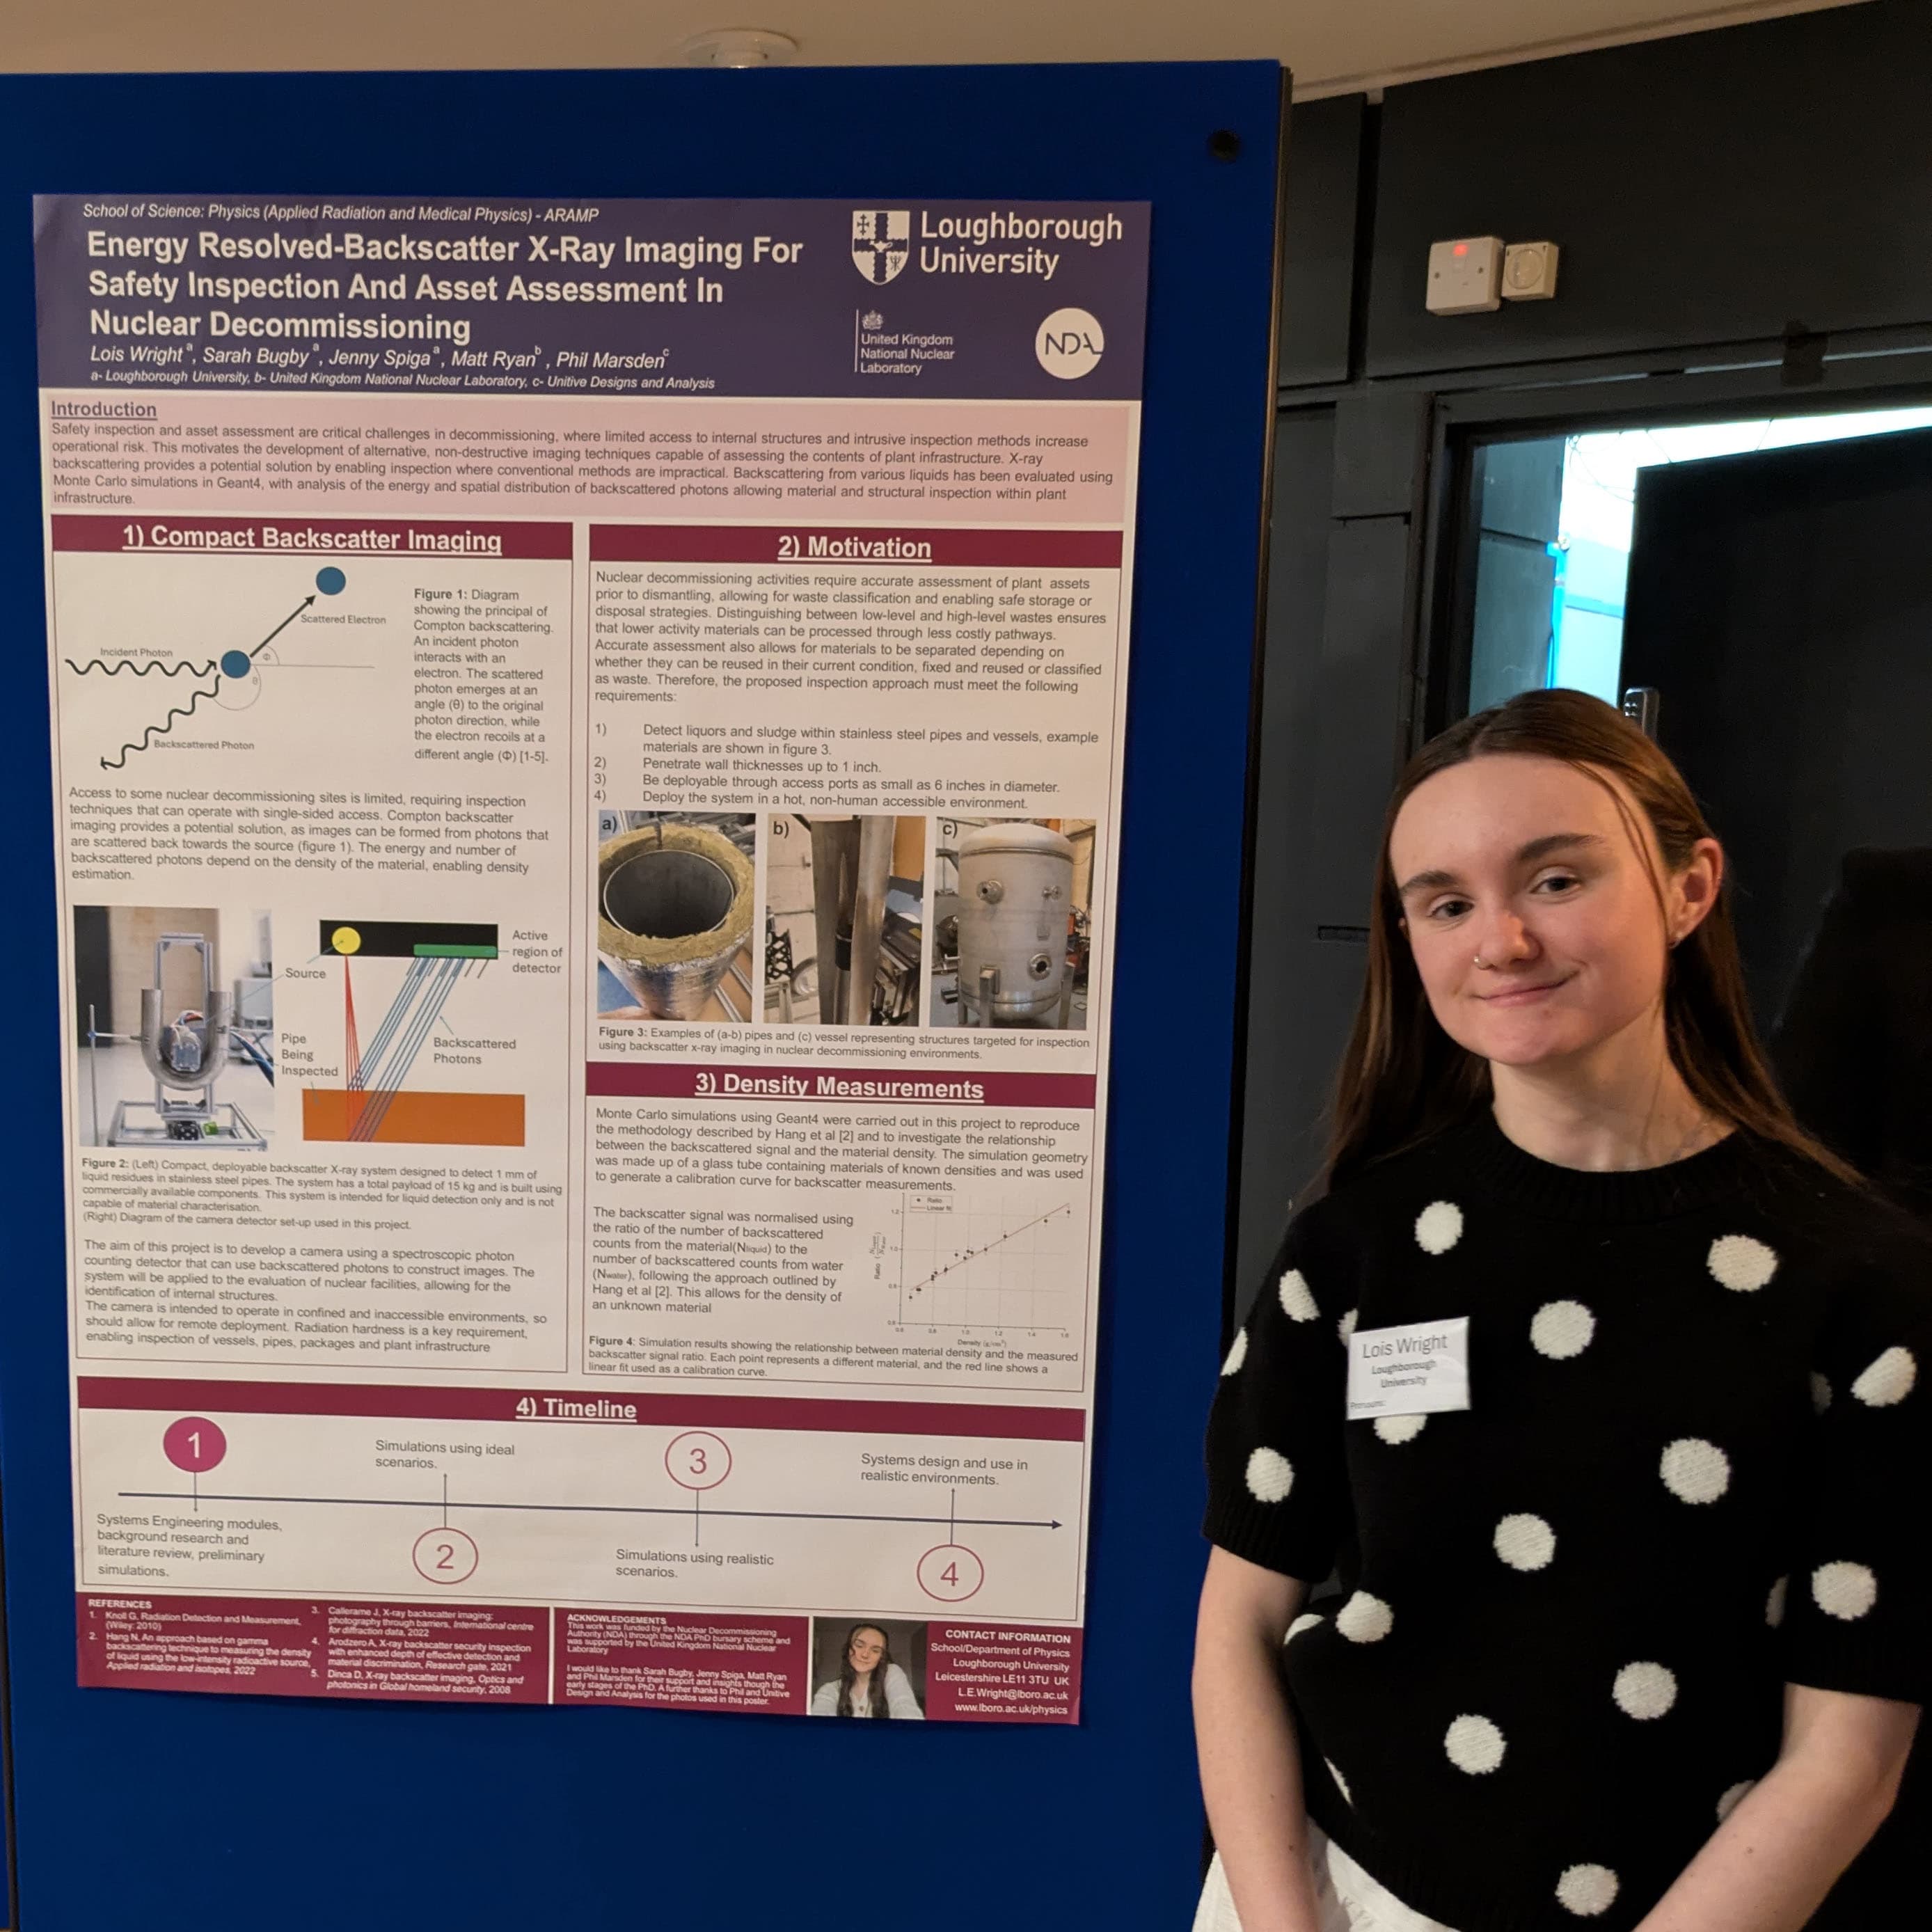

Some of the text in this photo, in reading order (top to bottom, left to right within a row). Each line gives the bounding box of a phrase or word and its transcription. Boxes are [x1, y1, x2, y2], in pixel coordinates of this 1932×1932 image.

[83, 203, 129, 217] School
[130, 203, 145, 217] of
[148, 203, 205, 218] Science:
[207, 203, 260, 221] Physics
[263, 204, 319, 221] (Applied
[322, 205, 386, 220] Radiation
[388, 206, 415, 220] and
[418, 205, 472, 221] Medical
[474, 206, 532, 224] Physics)
[543, 207, 599, 223] ARAMP
[921, 210, 1122, 246] Loughborough
[88, 230, 803, 269] Energy Resolved-Backscatter X-Ray Imaging For
[920, 246, 1059, 280] University
[88, 269, 722, 303] Safety Inspection And Asset Assessment In
[90, 309, 470, 346] Nuclear Decommissioning
[860, 333, 953, 348] United Kingdom
[1045, 333, 1104, 354] NDA
[90, 346, 588, 368] Lois Sarah Jenny Matt Phil
[860, 347, 955, 359] National Nuclear
[860, 361, 922, 376] Laboratory
[105, 370, 188, 385] Loughborough
[192, 370, 250, 386] University,
[269, 371, 308, 383] United
[310, 372, 361, 387] Kingdom
[364, 372, 413, 386] National
[415, 373, 462, 386] Nuclear
[464, 374, 528, 388] Laboratory,
[547, 375, 587, 387] Unitive
[589, 375, 638, 390] Designs
[640, 377, 664, 388] and
[665, 377, 715, 390] Analysis
[52, 400, 157, 418] Introduction
[123, 525, 501, 554] 1) Compact Backscatter Imaging
[777, 536, 931, 557] 2) Motivation
[413, 587, 519, 603] Figure 1: Diagram
[300, 614, 386, 624] Scattered Electron
[413, 603, 548, 619] showing the principal of
[100, 647, 173, 658] Incident Photon
[153, 739, 255, 750] Backscattered Photon
[594, 756, 606, 770] 2)
[642, 757, 701, 770] Penetrate
[704, 759, 728, 770] wall
[732, 759, 803, 771] thicknesses
[807, 762, 823, 774] up
[826, 761, 838, 773] to
[842, 761, 848, 772] 1
[601, 816, 618, 834] a)
[773, 821, 789, 839] b)
[942, 823, 959, 839] c)
[512, 929, 548, 941] Active
[512, 946, 563, 959] region of
[285, 967, 326, 979] Source
[512, 962, 562, 974] detector
[280, 1032, 306, 1045] Pipe
[433, 1036, 516, 1050] Backscattered
[281, 1048, 314, 1063] Being
[433, 1052, 482, 1065] Photons
[281, 1065, 338, 1077] Inspected
[695, 1073, 983, 1097] 3) Density Measurements
[84, 1285, 155, 1297] identification
[158, 1287, 171, 1298] of
[173, 1288, 215, 1299] internal
[592, 1299, 711, 1313] an unknown material
[1363, 1334, 1448, 1359] Lois Wright
[1371, 1359, 1436, 1375] Loughborough
[1381, 1376, 1428, 1388] University
[516, 1397, 637, 1418] 4) Timeline
[188, 1432, 199, 1458] 1
[375, 1439, 515, 1457] Simulations using ideal
[374, 1457, 437, 1469] scenarios.
[689, 1448, 707, 1474] 3
[861, 1452, 1028, 1470] Systems design and use in
[860, 1469, 999, 1485] realistic environments.
[96, 1513, 282, 1532] Systems Engineering modules,
[97, 1530, 249, 1545] background research and
[97, 1544, 264, 1564] literature review, preliminary
[436, 1544, 454, 1569] 2
[615, 1548, 774, 1566] Simulations using realistic
[97, 1563, 169, 1577] simulations.
[940, 1561, 959, 1587] 4
[945, 1629, 1071, 1644] CONTACT INFORMATION
[930, 1642, 1070, 1658] School/Department of Physics
[953, 1657, 1070, 1673] Loughborough University
[935, 1671, 1070, 1686] Leicestershire LE11 3TU UK
[958, 1687, 1068, 1700] L.E.Wright@lboro.ac.uk
[954, 1702, 1068, 1716] www.lboro.ac.uk/physics
